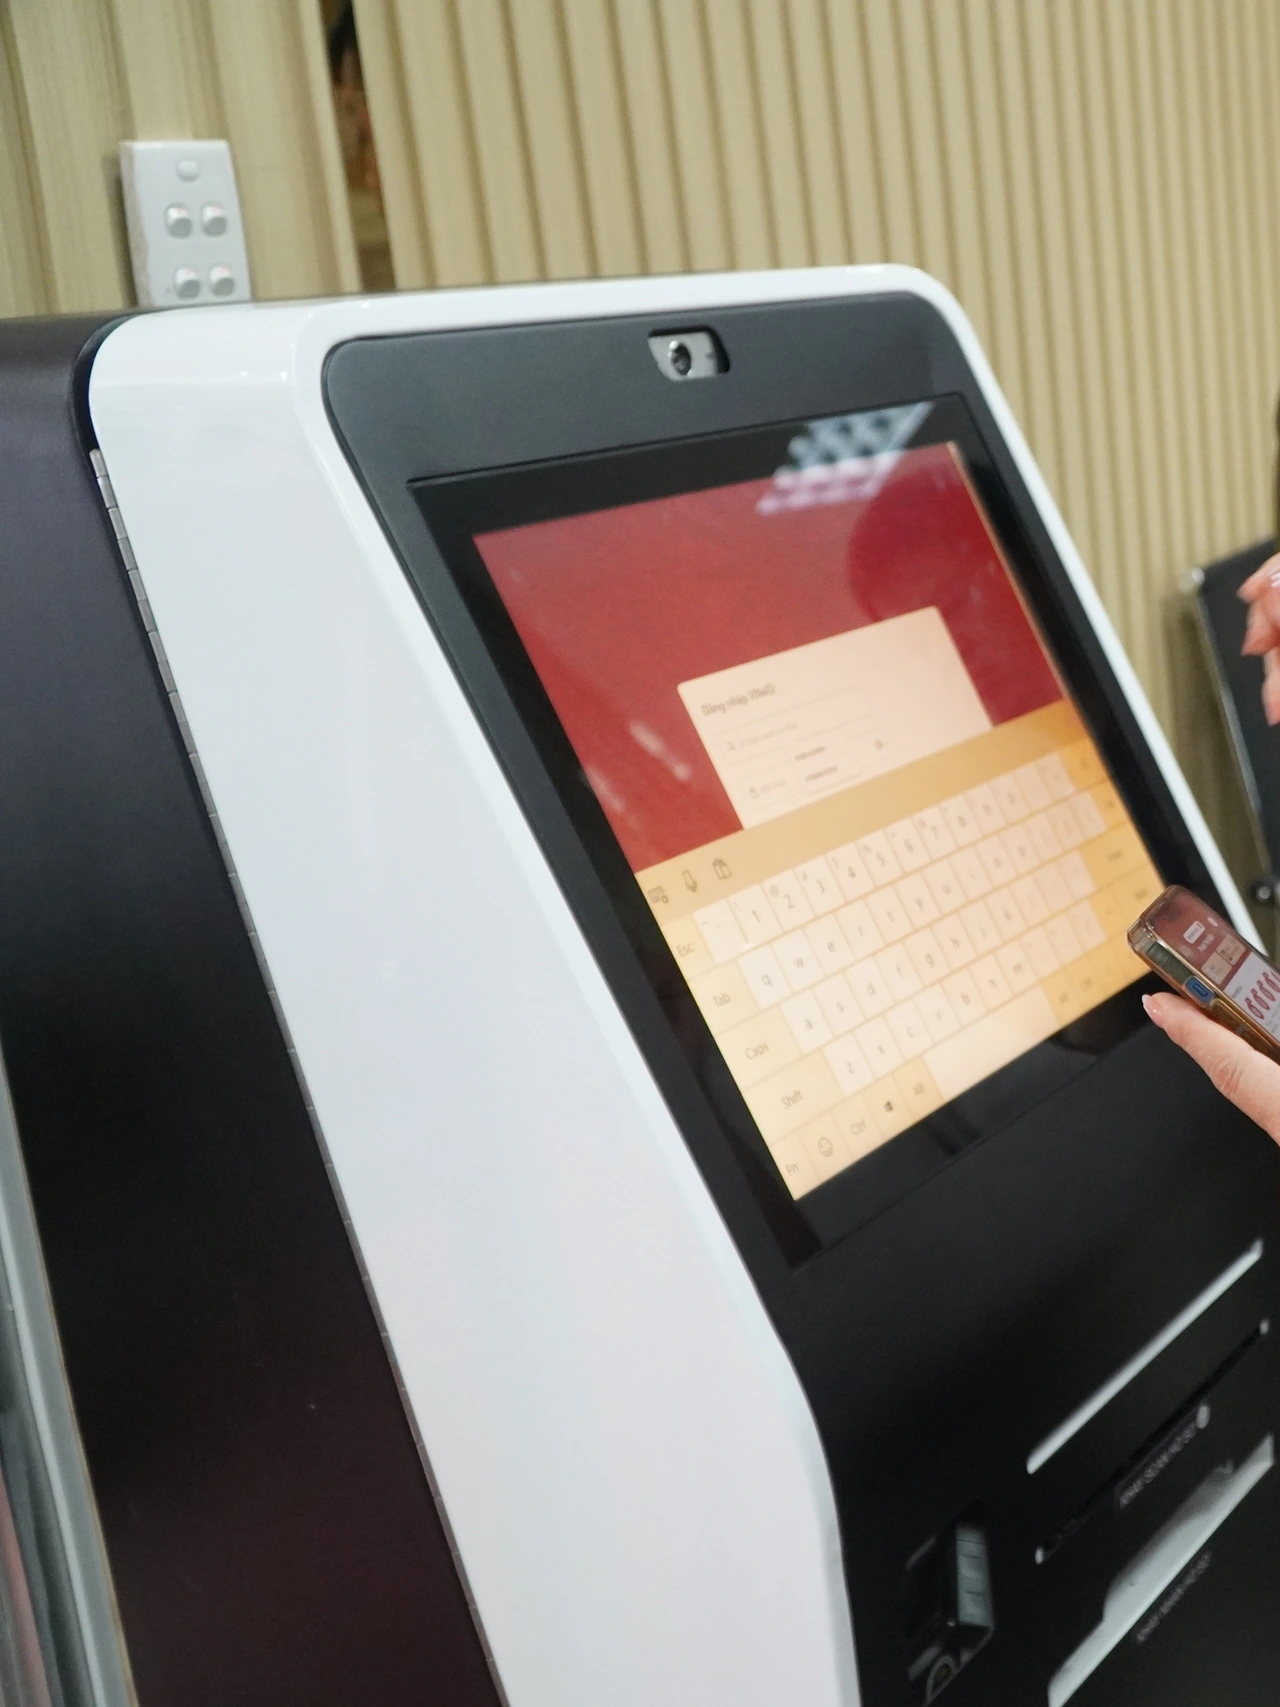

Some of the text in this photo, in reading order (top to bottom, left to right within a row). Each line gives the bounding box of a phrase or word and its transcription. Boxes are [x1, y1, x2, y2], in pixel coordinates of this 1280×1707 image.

[676, 943, 694, 957] Esc
[713, 993, 730, 1007] Tab
[746, 1042, 769, 1059] Caps
[782, 1090, 803, 1109] Shift
[785, 1164, 799, 1176] Fn
[850, 1119, 867, 1136] Ctrl
